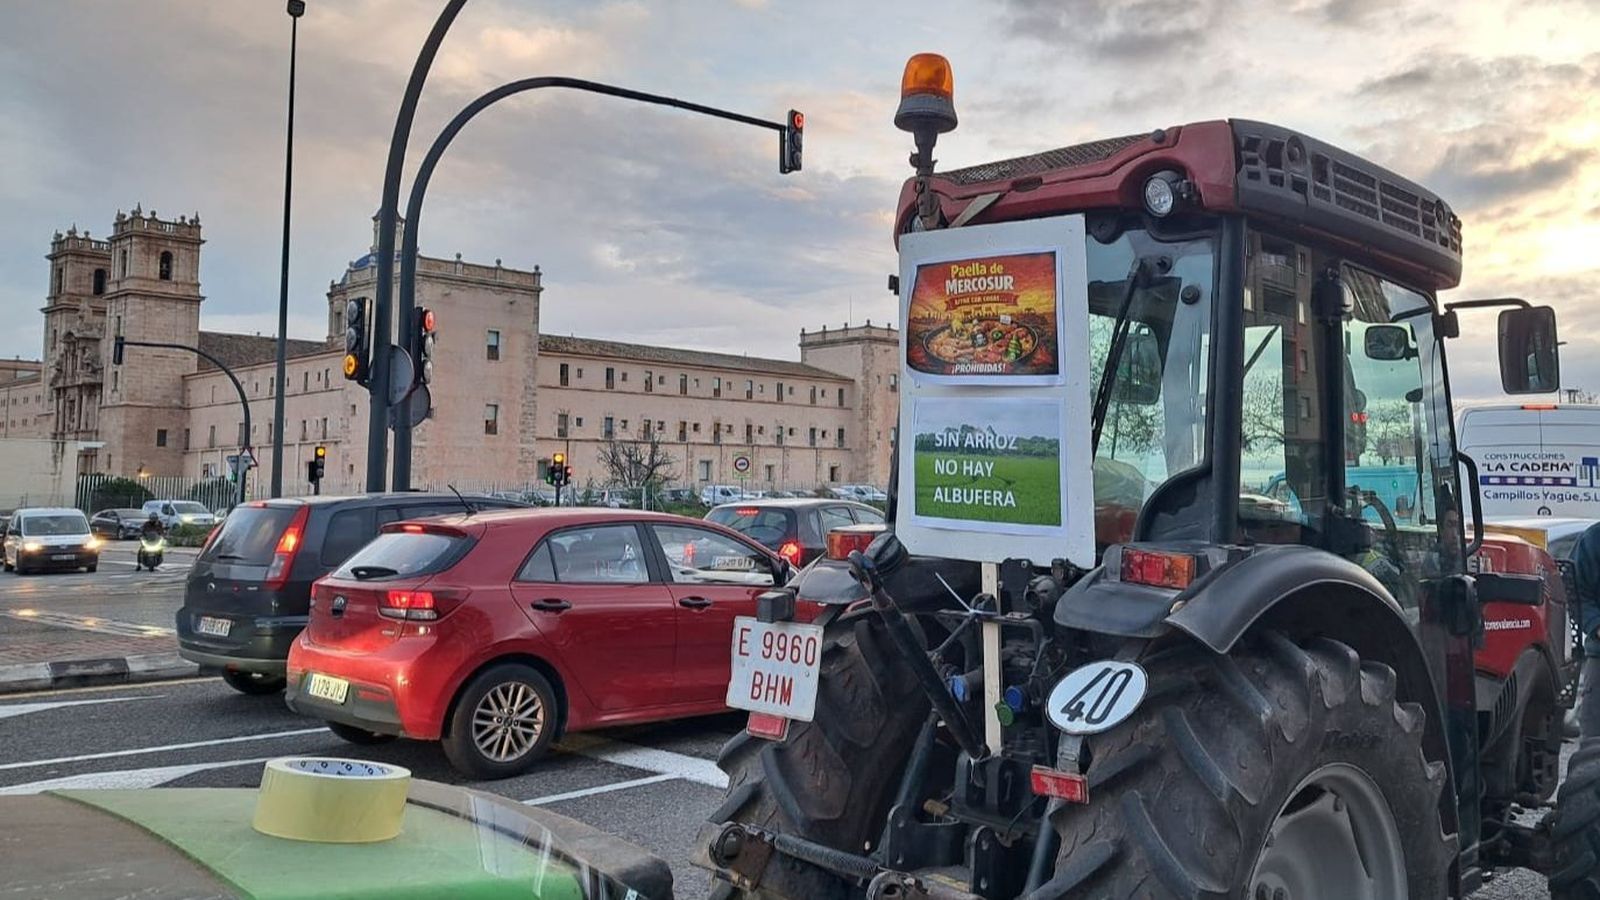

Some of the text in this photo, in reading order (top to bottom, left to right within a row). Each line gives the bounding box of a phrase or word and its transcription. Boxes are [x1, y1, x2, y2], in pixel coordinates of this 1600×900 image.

[951, 262, 1004, 279] Paella de
[945, 275, 1014, 296] MERCOSUR
[951, 363, 1006, 375] ¡PROHIBIDAS!
[935, 432, 1018, 450] SIN ARROZ
[1484, 452, 1565, 460] CONSTRUCCIONES
[935, 459, 994, 477] NO HAY
[1482, 462, 1574, 472] "LA CADENA"
[933, 486, 1016, 507] ALBUFERA
[1484, 490, 1540, 501] Campillos
[739, 627, 817, 666] E 9960
[751, 670, 793, 706] BHM
[1060, 667, 1133, 725] 40
